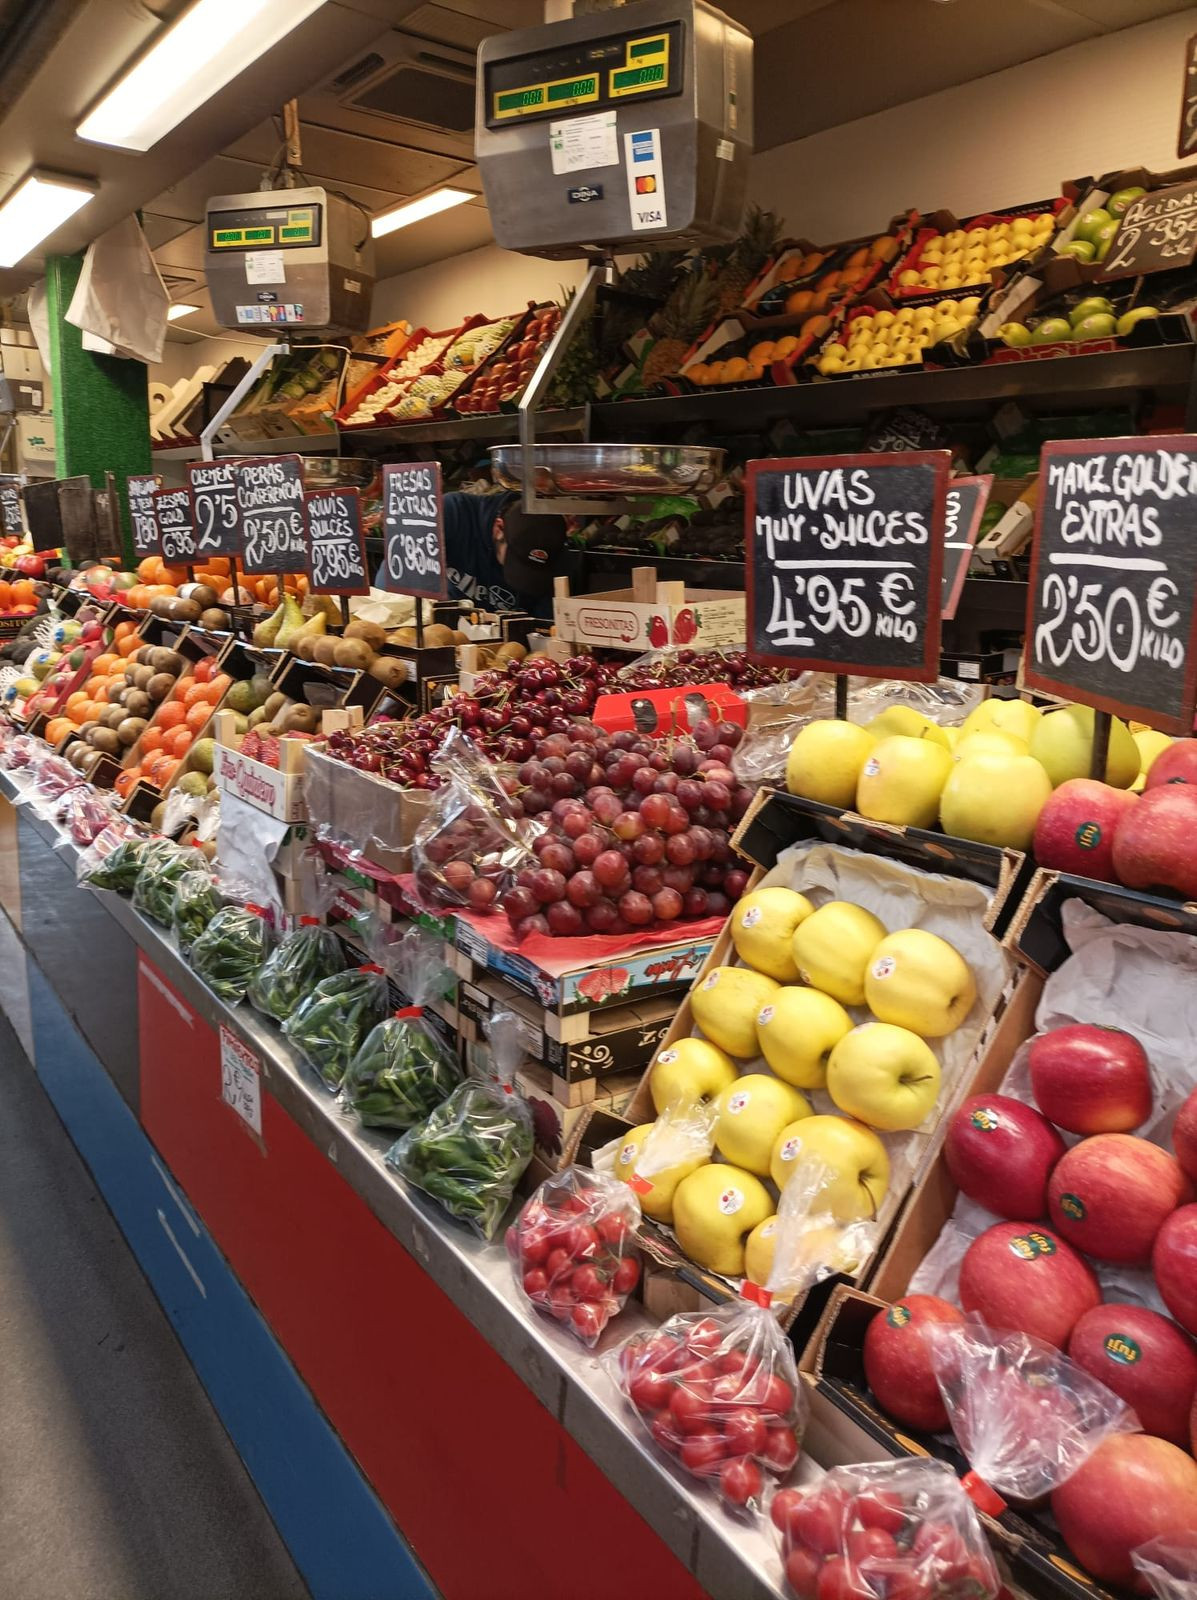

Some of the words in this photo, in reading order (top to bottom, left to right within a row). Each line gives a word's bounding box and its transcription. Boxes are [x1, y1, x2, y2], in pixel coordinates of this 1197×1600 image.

[637, 211, 662, 224] VISA
[241, 463, 285, 488] PERAS
[389, 469, 432, 493] FRESAS
[237, 478, 304, 508] CONFERENCIA
[784, 468, 876, 511] UVAS
[159, 508, 184, 525] GOLD
[389, 494, 438, 517] EXTRAS
[310, 518, 353, 539] DULCES
[1061, 500, 1162, 548] EXTRAS
[875, 612, 918, 643] KILO
[1140, 623, 1184, 669] KILO
[1106, 1338, 1137, 1361] fuji
